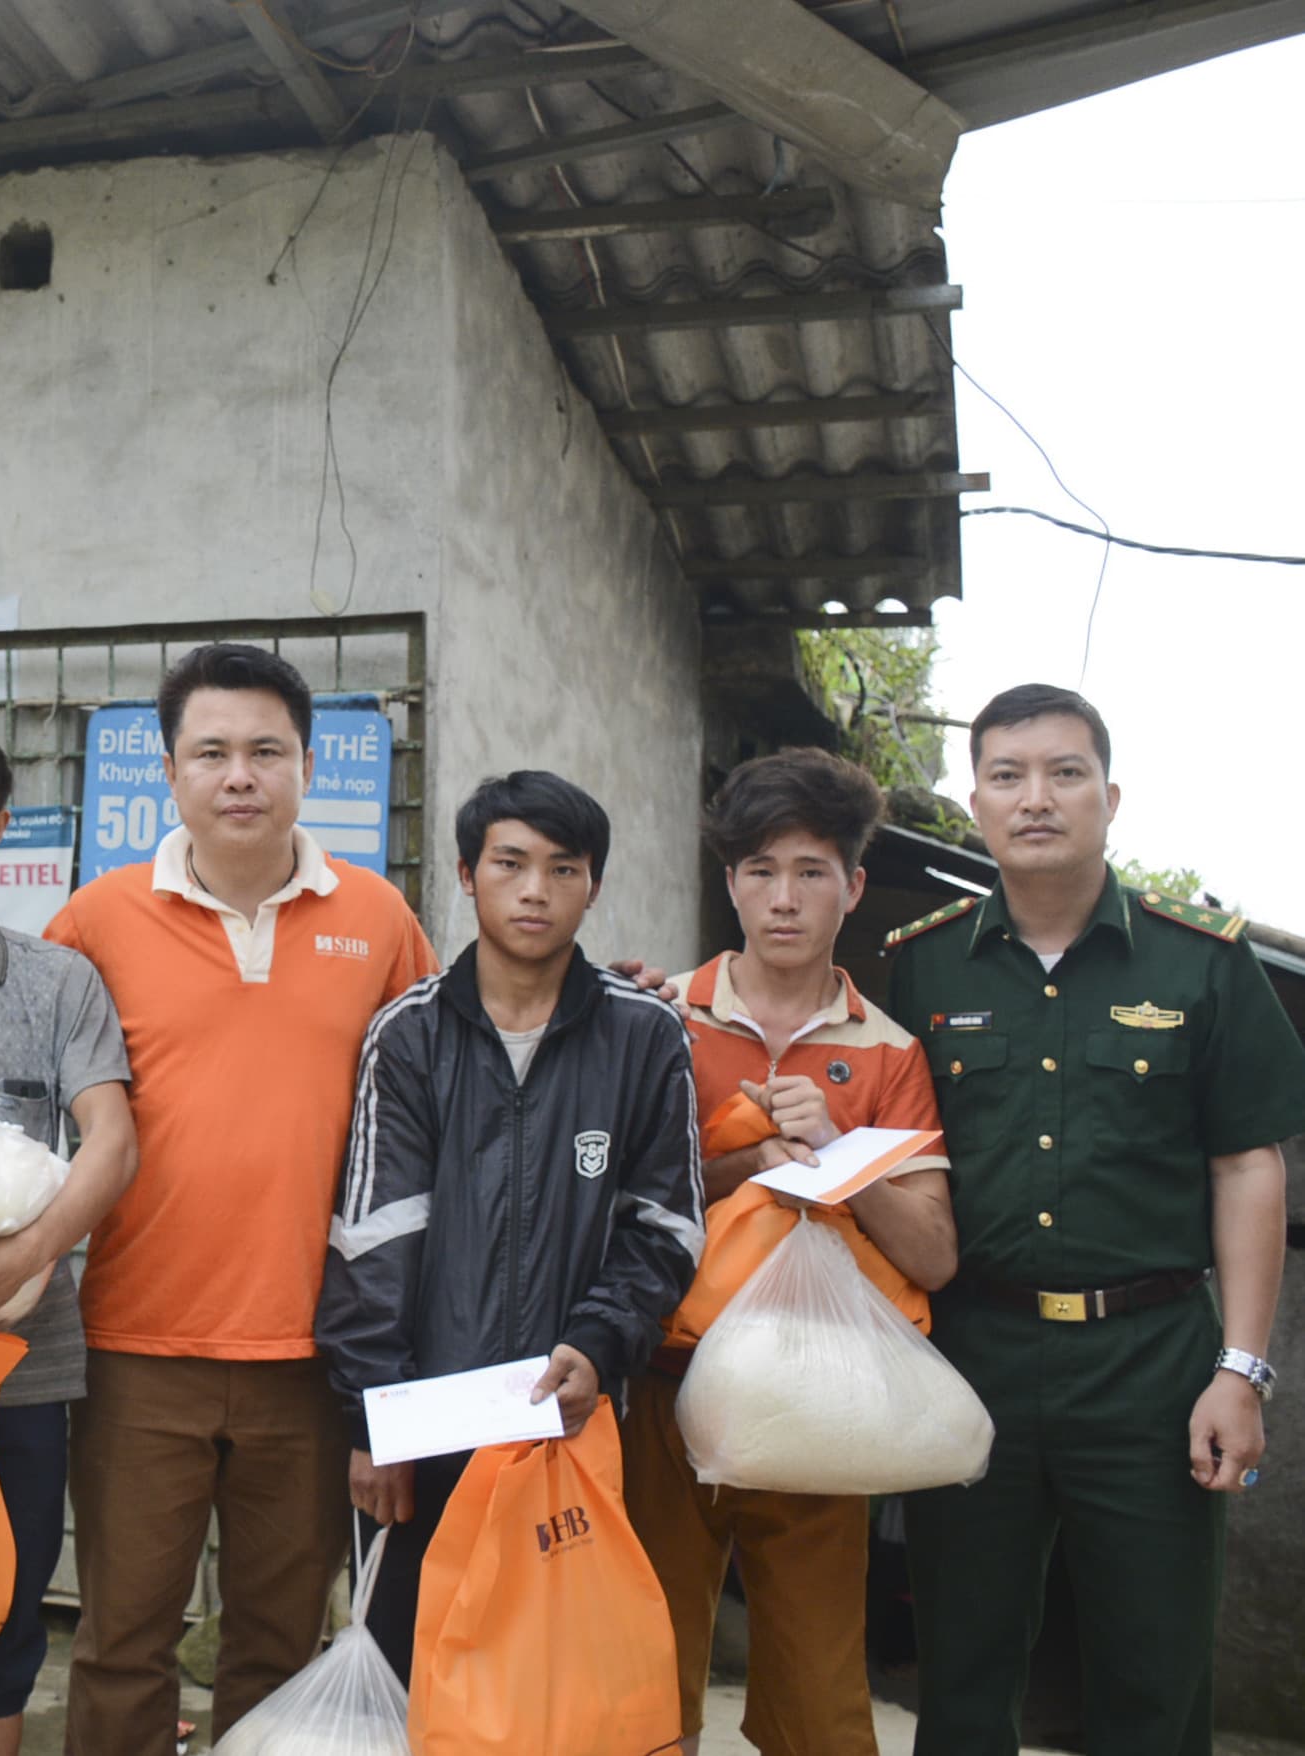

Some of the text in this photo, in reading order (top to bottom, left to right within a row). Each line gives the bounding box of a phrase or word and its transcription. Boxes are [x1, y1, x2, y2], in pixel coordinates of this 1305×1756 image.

[98, 717, 379, 762] ĐIỂM THẺ
[334, 936, 369, 956] SHB
